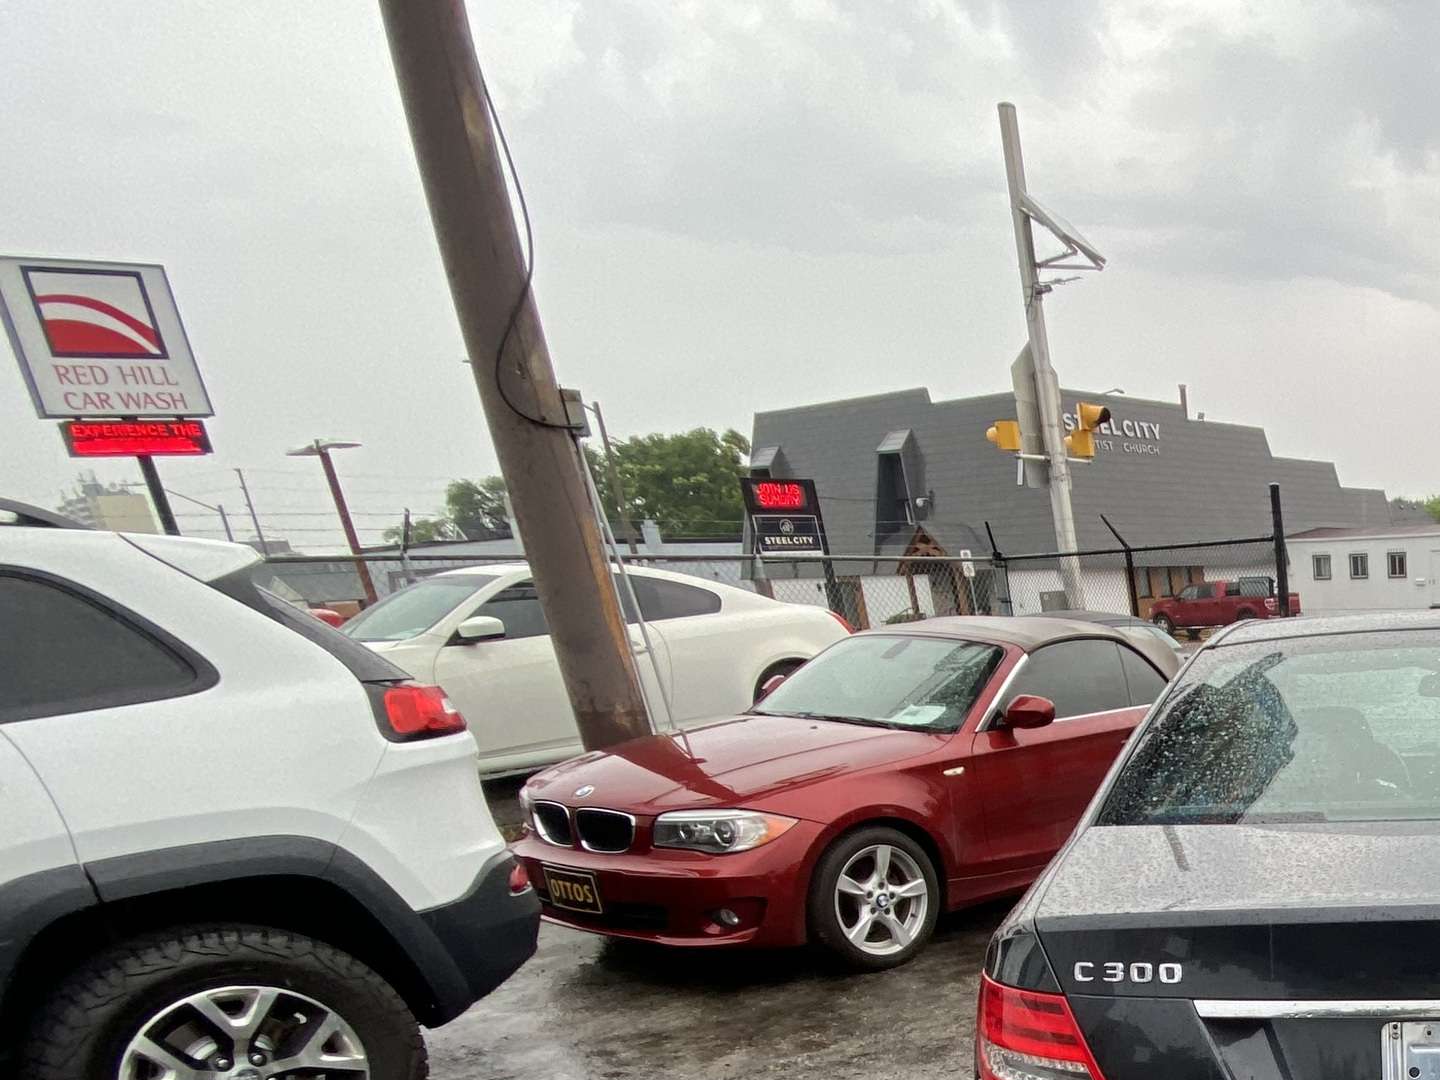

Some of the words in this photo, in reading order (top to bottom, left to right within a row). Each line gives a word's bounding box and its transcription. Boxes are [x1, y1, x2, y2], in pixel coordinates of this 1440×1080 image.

[52, 364, 109, 386] RED
[117, 365, 179, 387] HILL
[64, 391, 115, 411] CAR
[115, 391, 190, 411] WASH
[173, 424, 203, 437] THE
[1123, 442, 1160, 456] CHURCH
[551, 878, 594, 904] OTTOS
